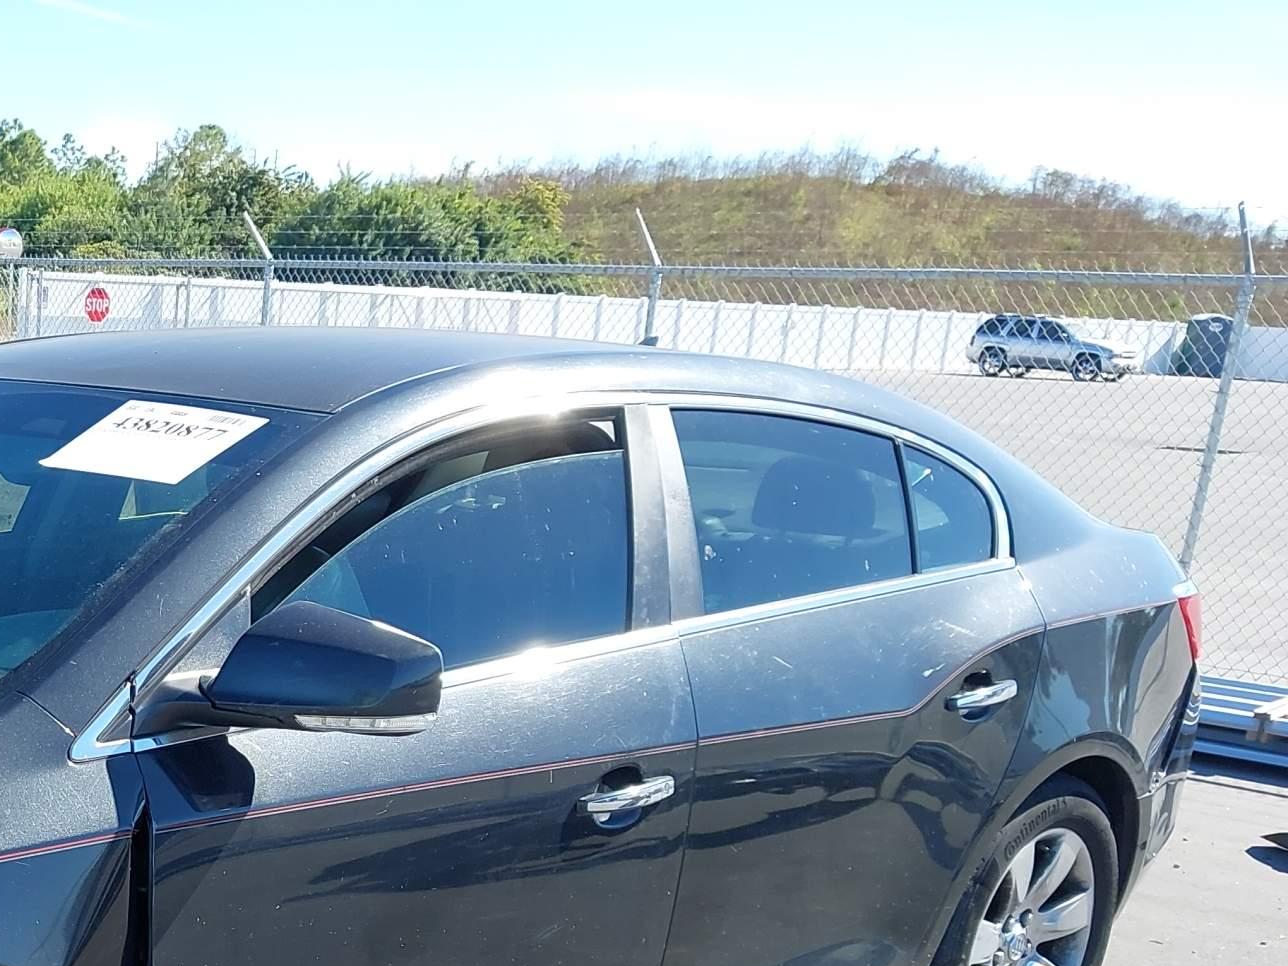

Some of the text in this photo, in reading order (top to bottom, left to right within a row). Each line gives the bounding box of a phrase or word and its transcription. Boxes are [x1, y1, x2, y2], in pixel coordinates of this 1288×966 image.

[85, 297, 110, 313] STOP
[112, 415, 230, 441] 43820877
[1004, 799, 1061, 861] Continental
